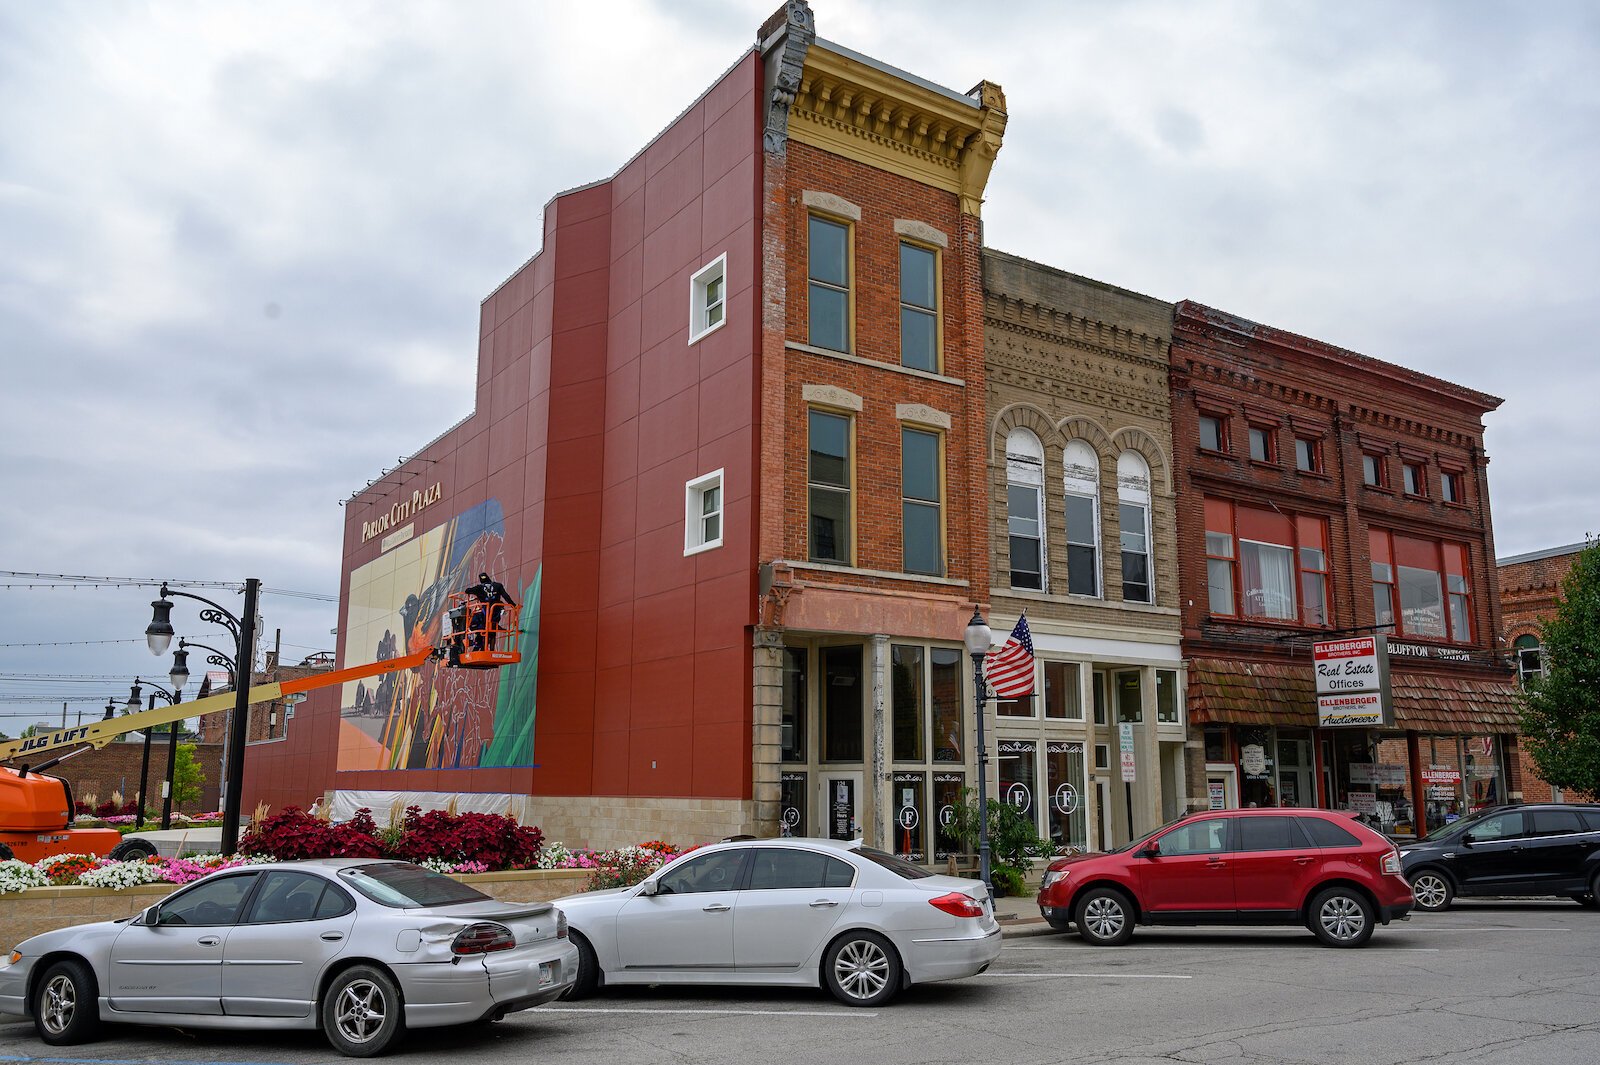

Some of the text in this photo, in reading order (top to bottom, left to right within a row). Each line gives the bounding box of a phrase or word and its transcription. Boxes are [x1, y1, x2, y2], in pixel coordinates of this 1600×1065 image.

[362, 513, 389, 543] PARLOR
[390, 500, 412, 527] CITY
[412, 482, 442, 514] PLAZA
[1315, 639, 1373, 653] ELLENBERGER
[1387, 642, 1428, 657] BLUFFTON
[1317, 660, 1374, 678] Real Estate
[1329, 679, 1364, 690] Offices
[1320, 696, 1377, 707] ELLENBERGER
[1322, 713, 1378, 725] Auctioneers
[19, 726, 89, 752] JLG LIFT
[1421, 771, 1460, 779] ELLENBERGER
[1014, 790, 1025, 807] F
[1061, 790, 1072, 807] F
[905, 811, 915, 824] F
